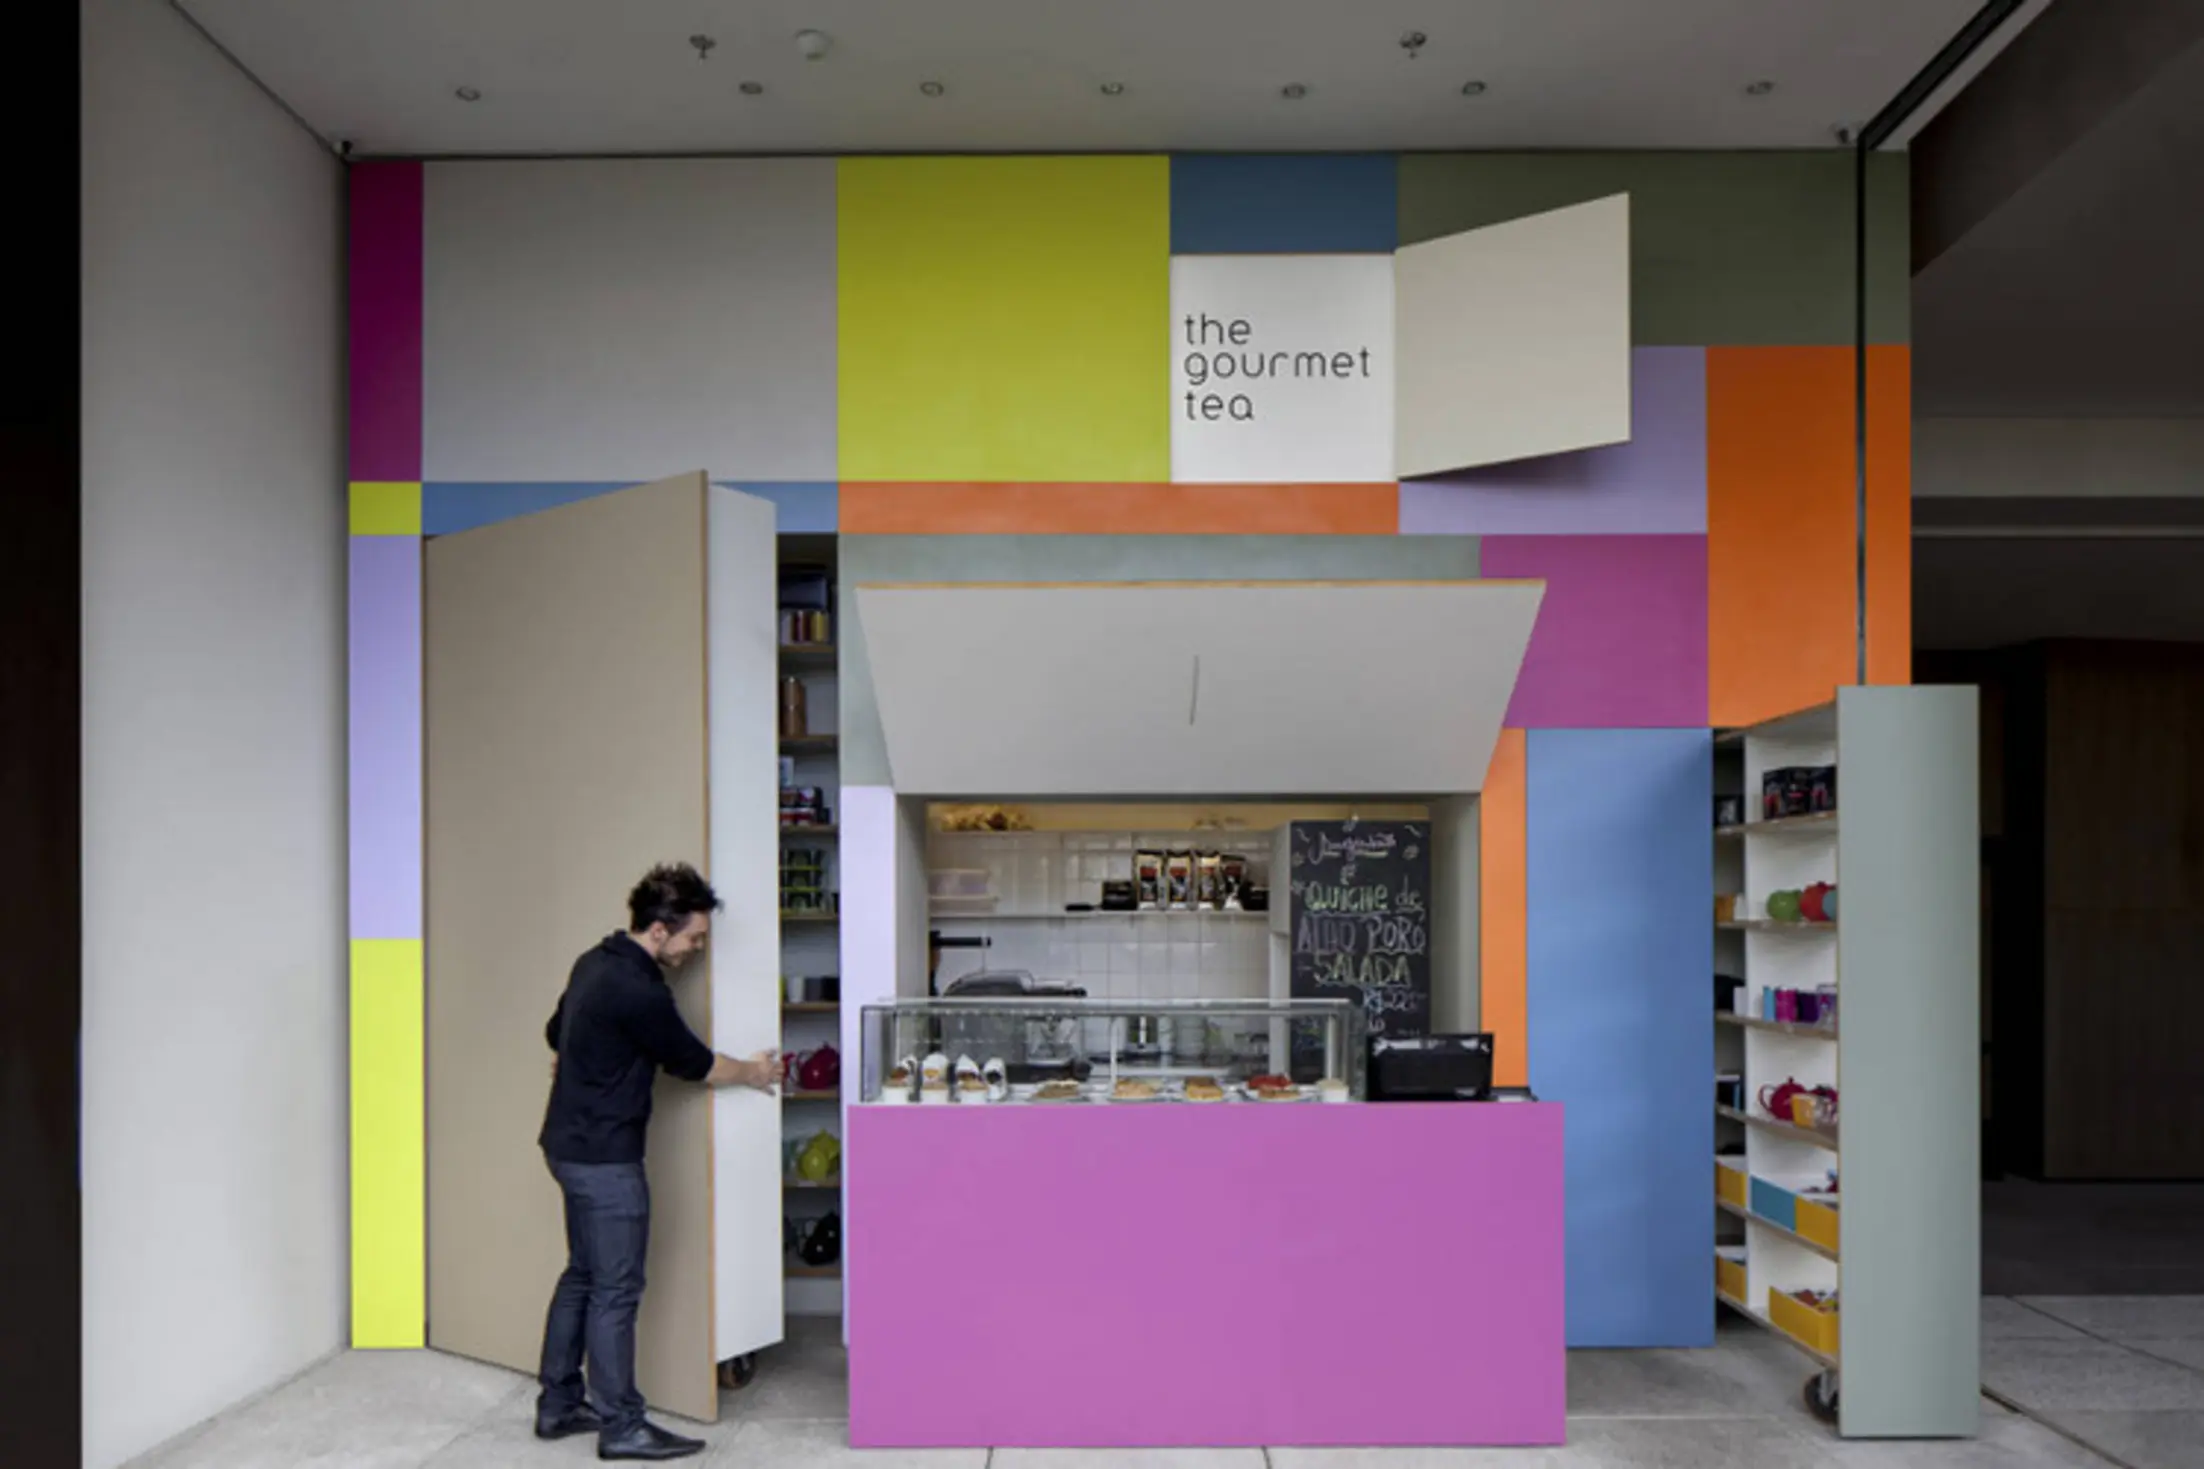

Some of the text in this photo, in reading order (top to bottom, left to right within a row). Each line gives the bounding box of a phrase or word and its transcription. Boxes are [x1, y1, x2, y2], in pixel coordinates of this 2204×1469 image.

[1184, 312, 1251, 345] the
[1184, 347, 1371, 386] gourmet
[1184, 391, 1254, 421] tea
